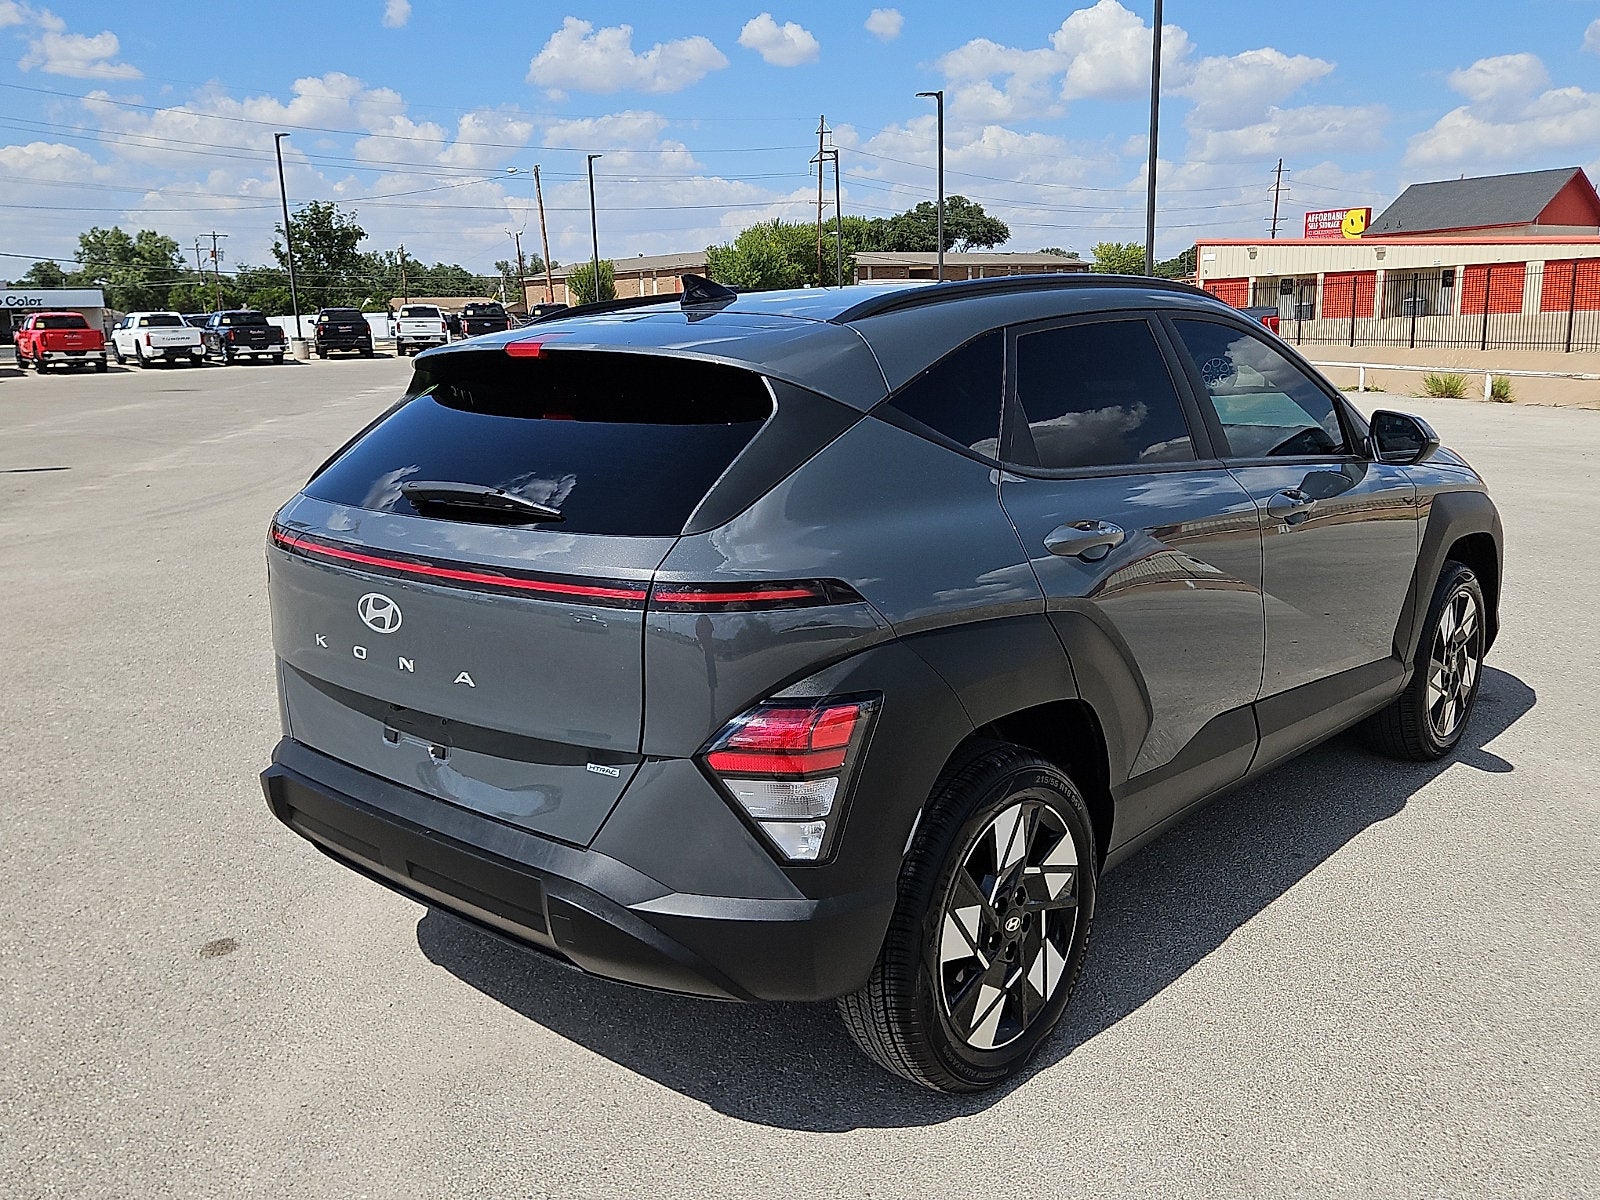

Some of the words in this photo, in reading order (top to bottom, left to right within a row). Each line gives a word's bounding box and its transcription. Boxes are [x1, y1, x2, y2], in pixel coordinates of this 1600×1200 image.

[1307, 211, 1347, 223] AFFORDABLE
[1308, 222, 1319, 230] SELF
[1319, 220, 1341, 229] STORAGE
[5, 295, 43, 307] Color
[315, 633, 477, 688] KONA
[588, 765, 618, 776] HTRAC
[1035, 775, 1060, 788] 215/55
[1059, 782, 1072, 798] R18
